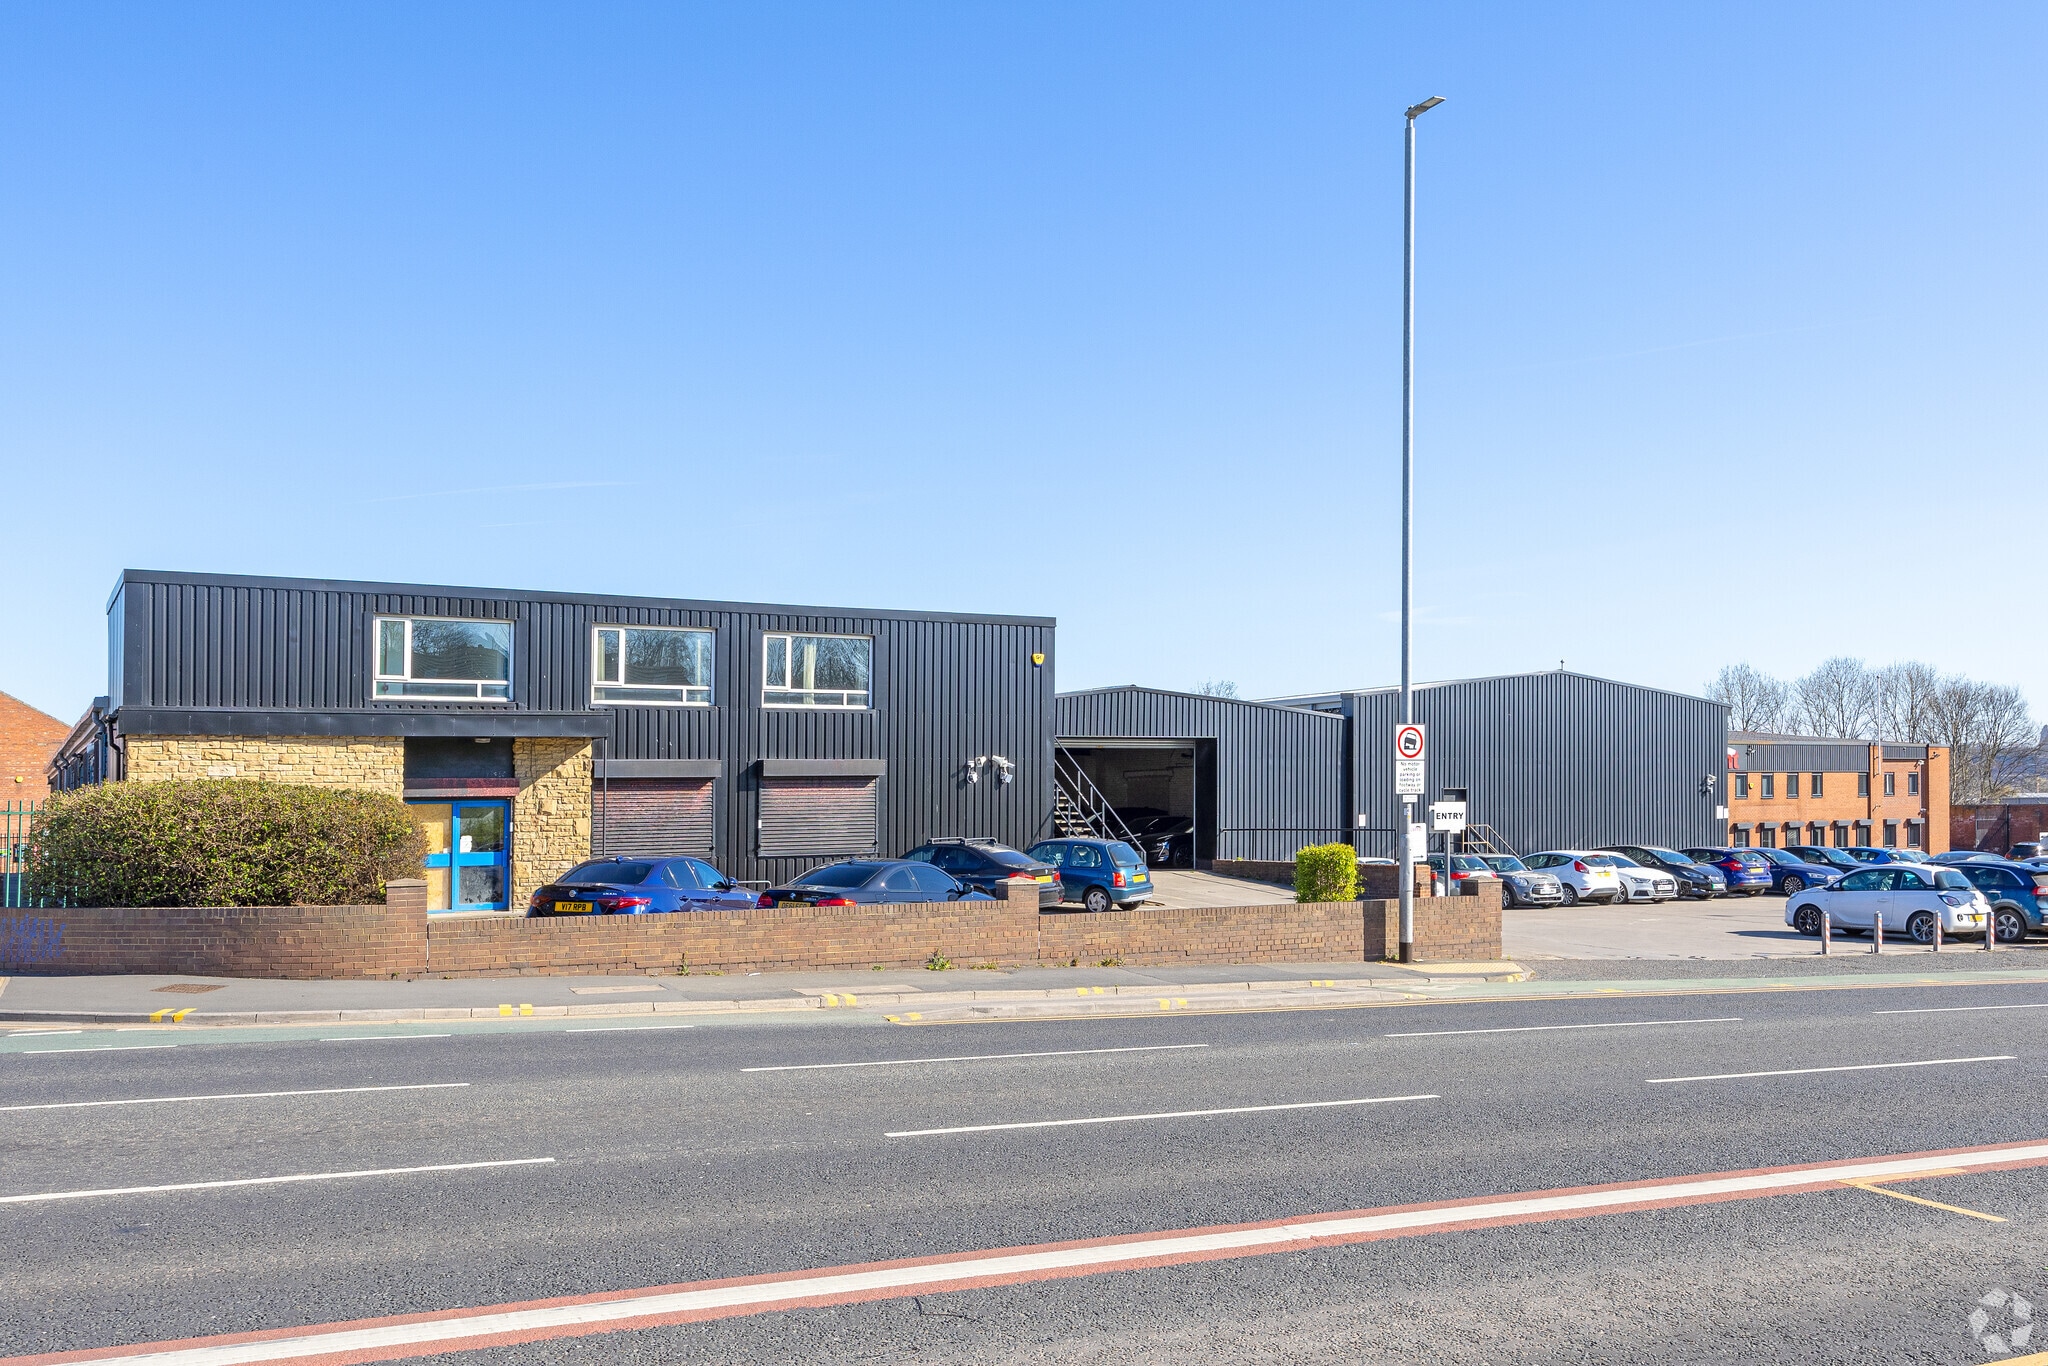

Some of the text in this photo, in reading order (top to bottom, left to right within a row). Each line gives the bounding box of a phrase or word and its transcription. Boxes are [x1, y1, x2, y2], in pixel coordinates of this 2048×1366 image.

[1436, 812, 1464, 820] ENTRY
[561, 902, 587, 911] V17 RPB
